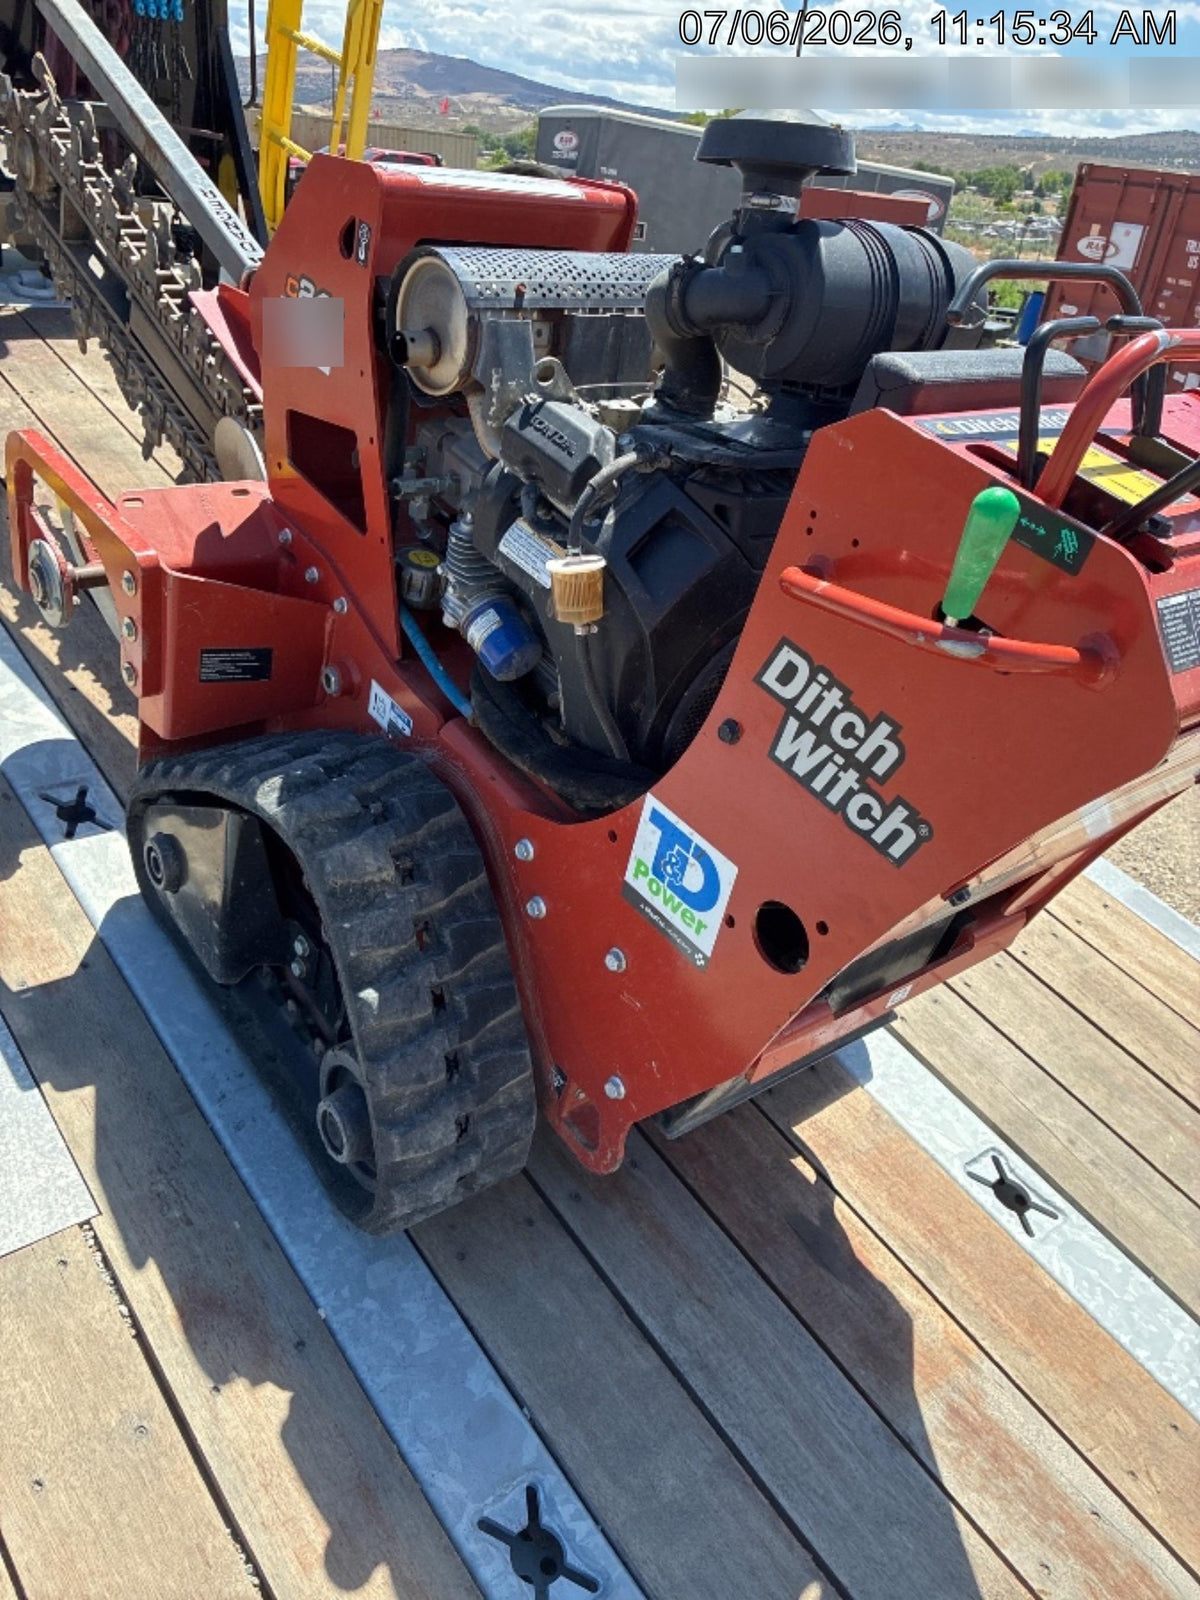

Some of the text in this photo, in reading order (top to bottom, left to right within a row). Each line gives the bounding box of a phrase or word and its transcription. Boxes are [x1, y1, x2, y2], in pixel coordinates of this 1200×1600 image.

[761, 644, 899, 777] Ditch
[632, 857, 709, 936] Power
[648, 806, 721, 913] T&D
